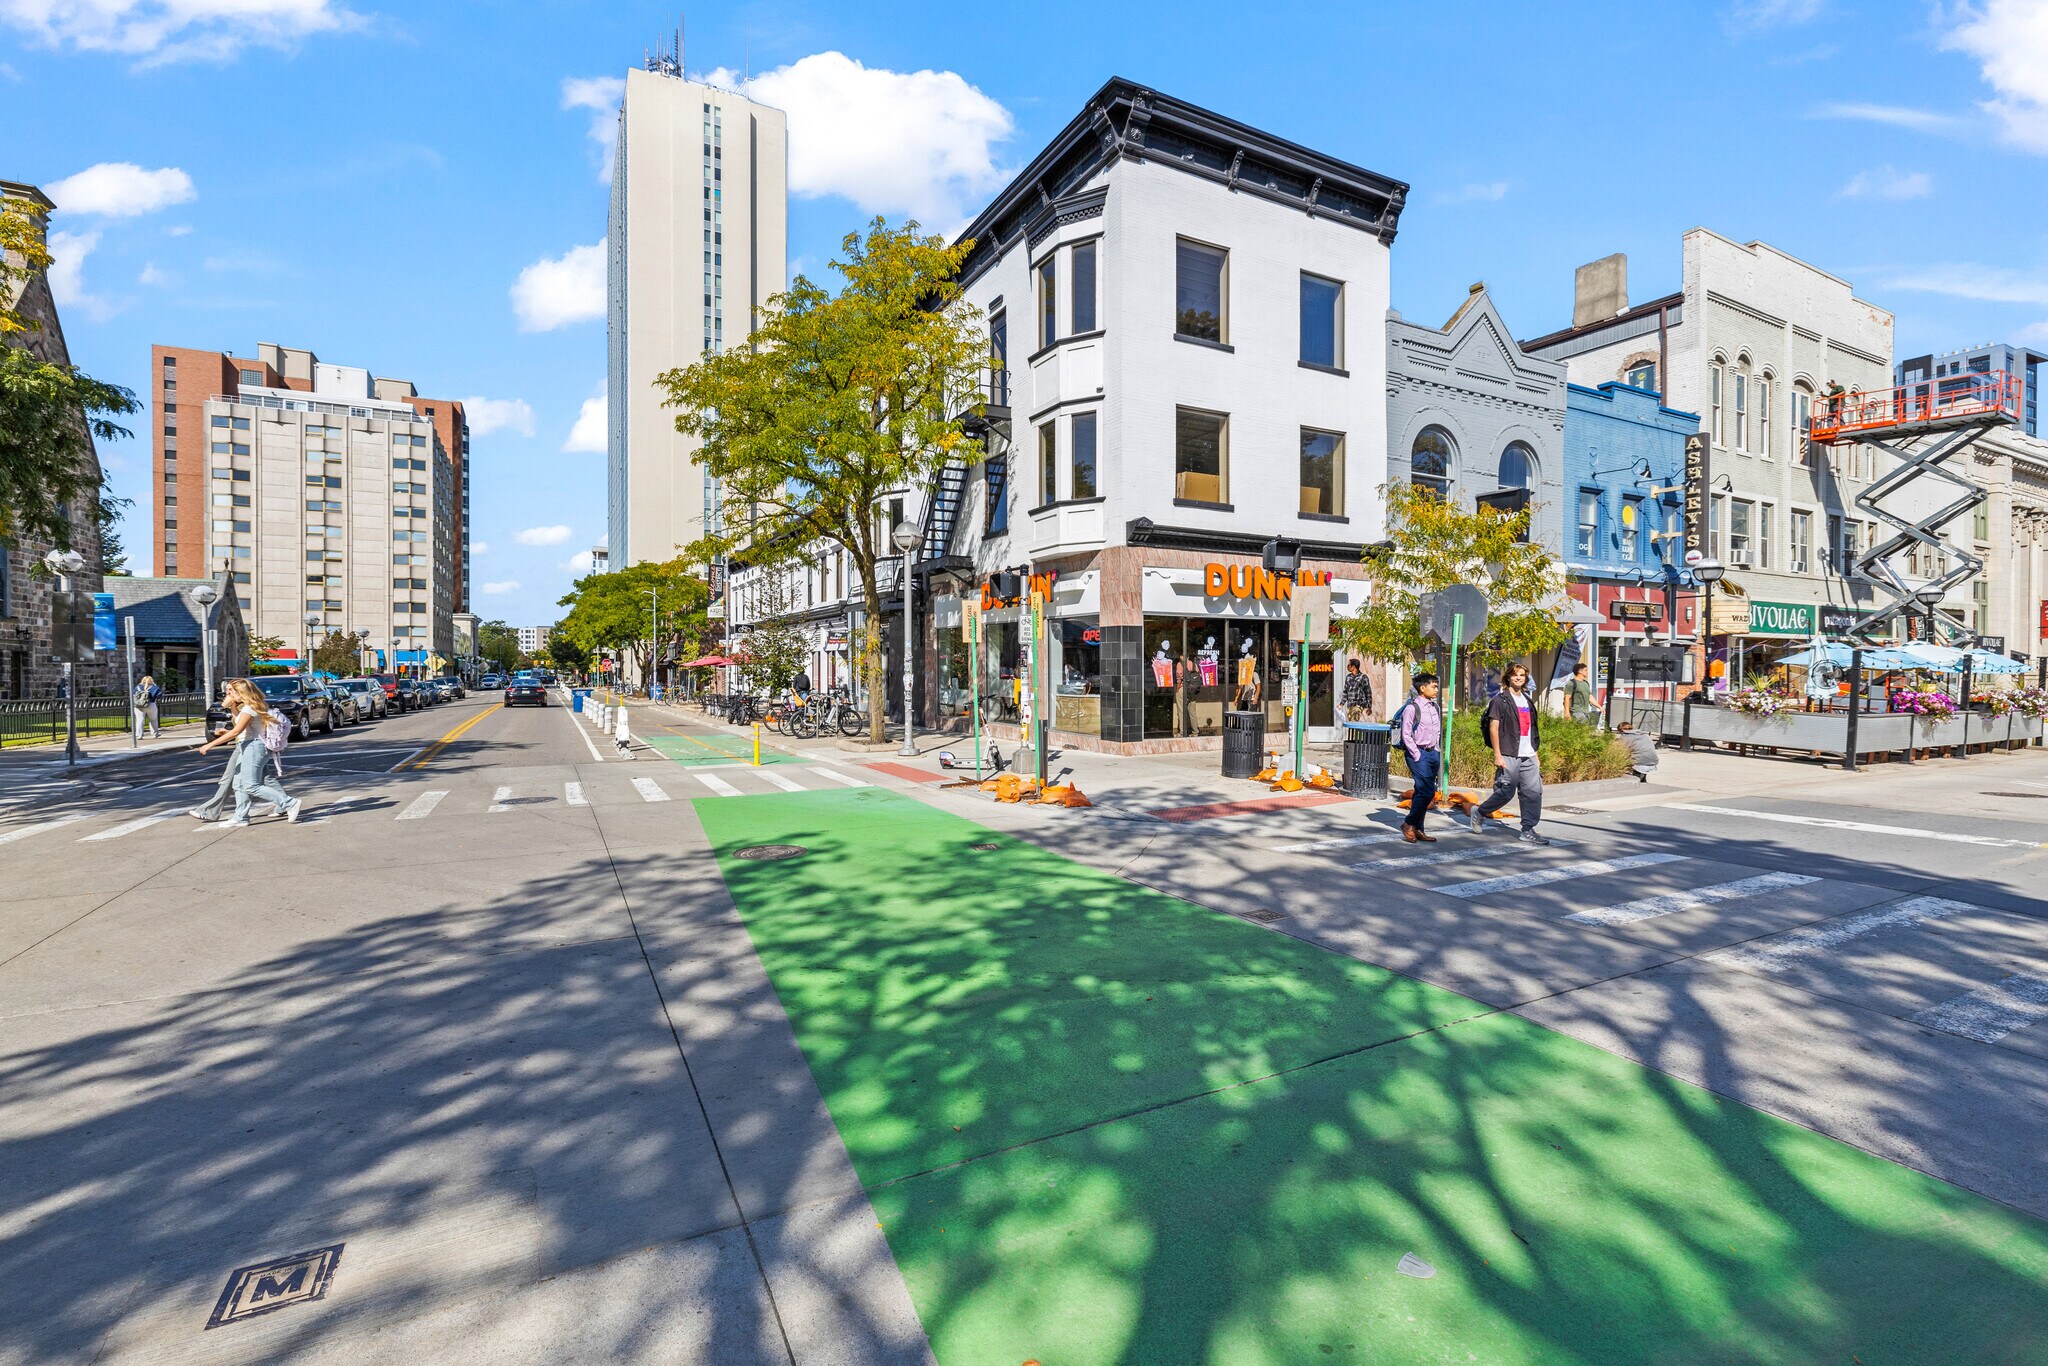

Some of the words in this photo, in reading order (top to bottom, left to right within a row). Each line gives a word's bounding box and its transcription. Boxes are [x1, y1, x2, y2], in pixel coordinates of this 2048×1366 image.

[1685, 437, 1703, 548] ASHLEY'S
[981, 569, 1056, 611] DIN'
[1083, 630, 1100, 641] OPE
[1308, 664, 1334, 673] NKIN'
[250, 1266, 309, 1303] M
